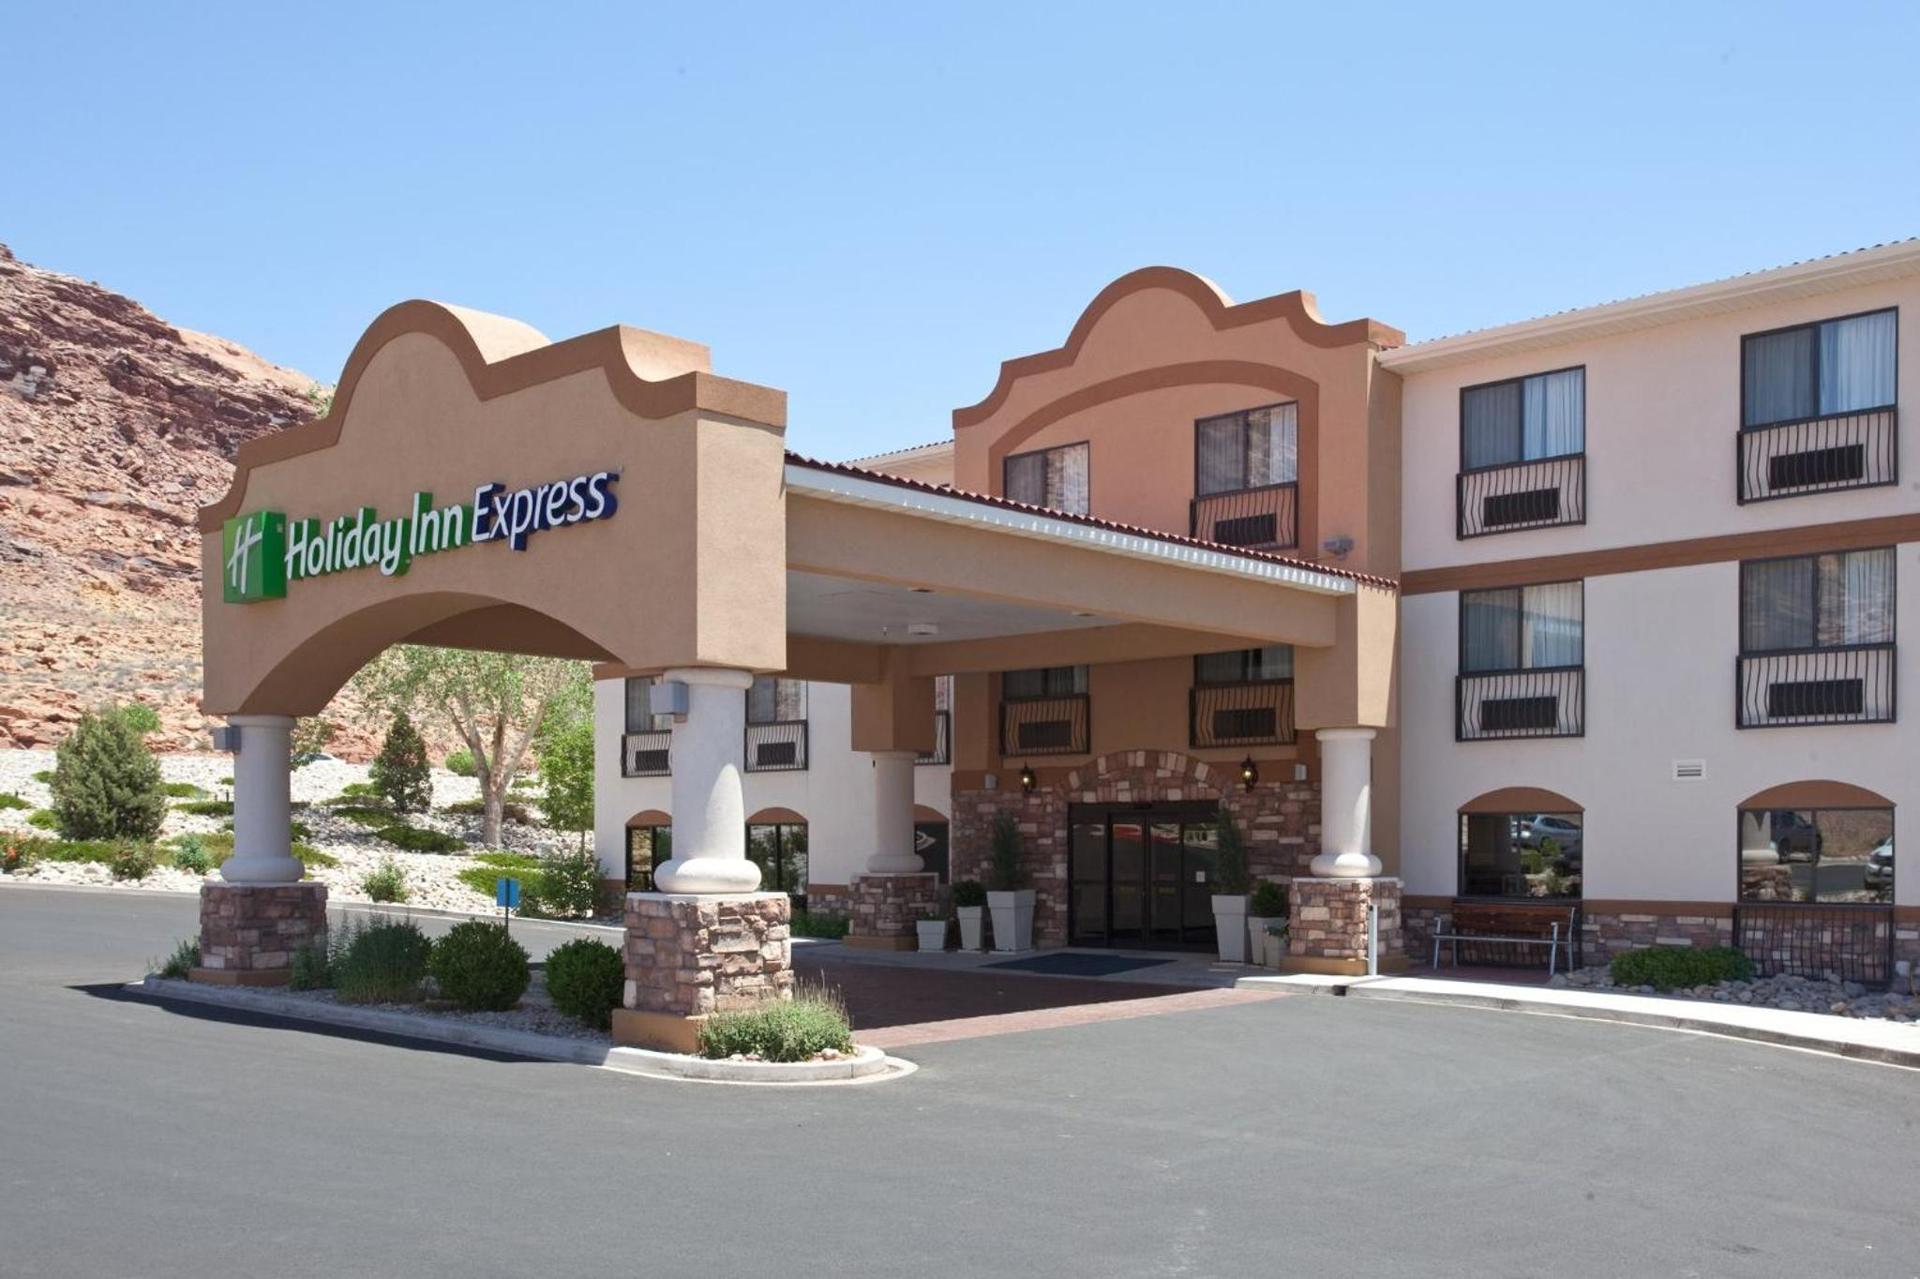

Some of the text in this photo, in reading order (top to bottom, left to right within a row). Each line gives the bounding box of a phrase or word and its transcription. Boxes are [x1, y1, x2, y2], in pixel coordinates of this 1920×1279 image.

[284, 471, 615, 578] Holiday Inn Express
